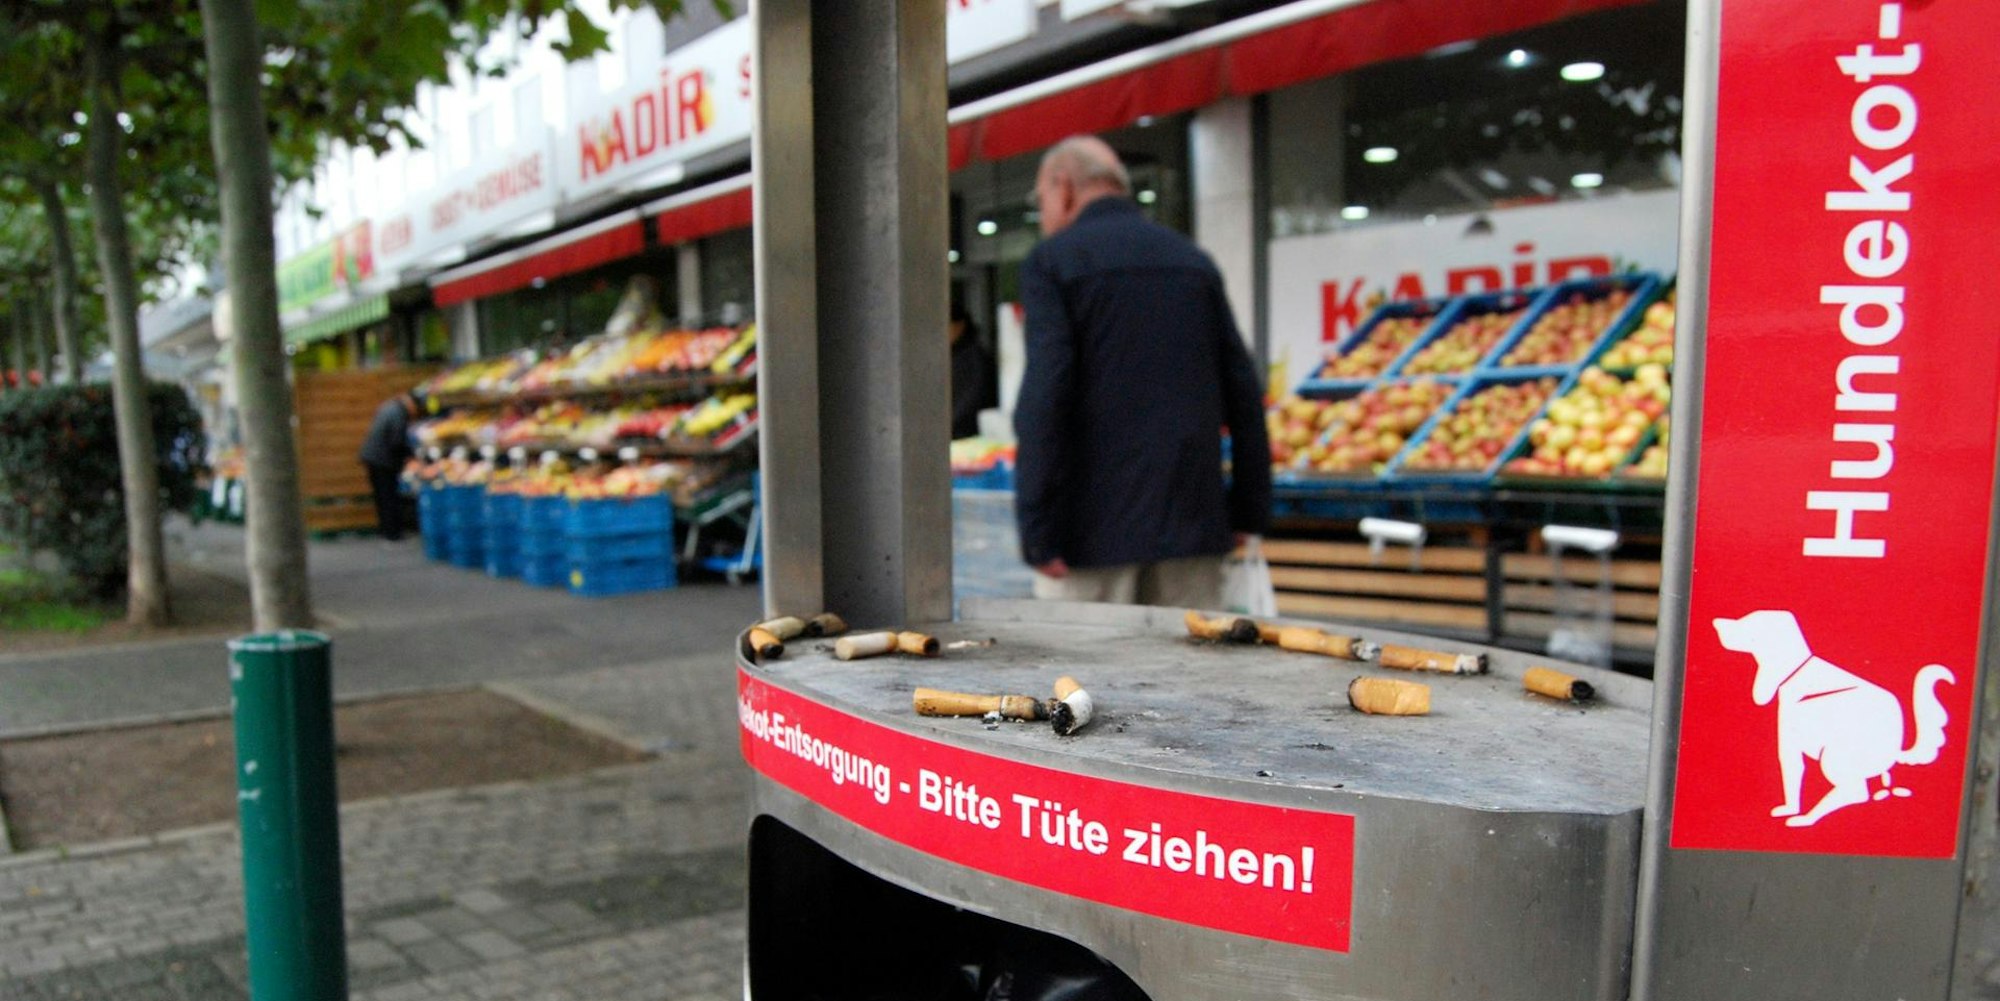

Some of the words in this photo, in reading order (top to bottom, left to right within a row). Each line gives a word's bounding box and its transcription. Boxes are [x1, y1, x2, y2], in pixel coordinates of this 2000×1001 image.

[1802, 3, 1922, 559] Hundekot-
[919, 770, 1002, 830] Bitte
[1012, 794, 1109, 855] Tüte
[1122, 822, 1316, 894] ziehen!
